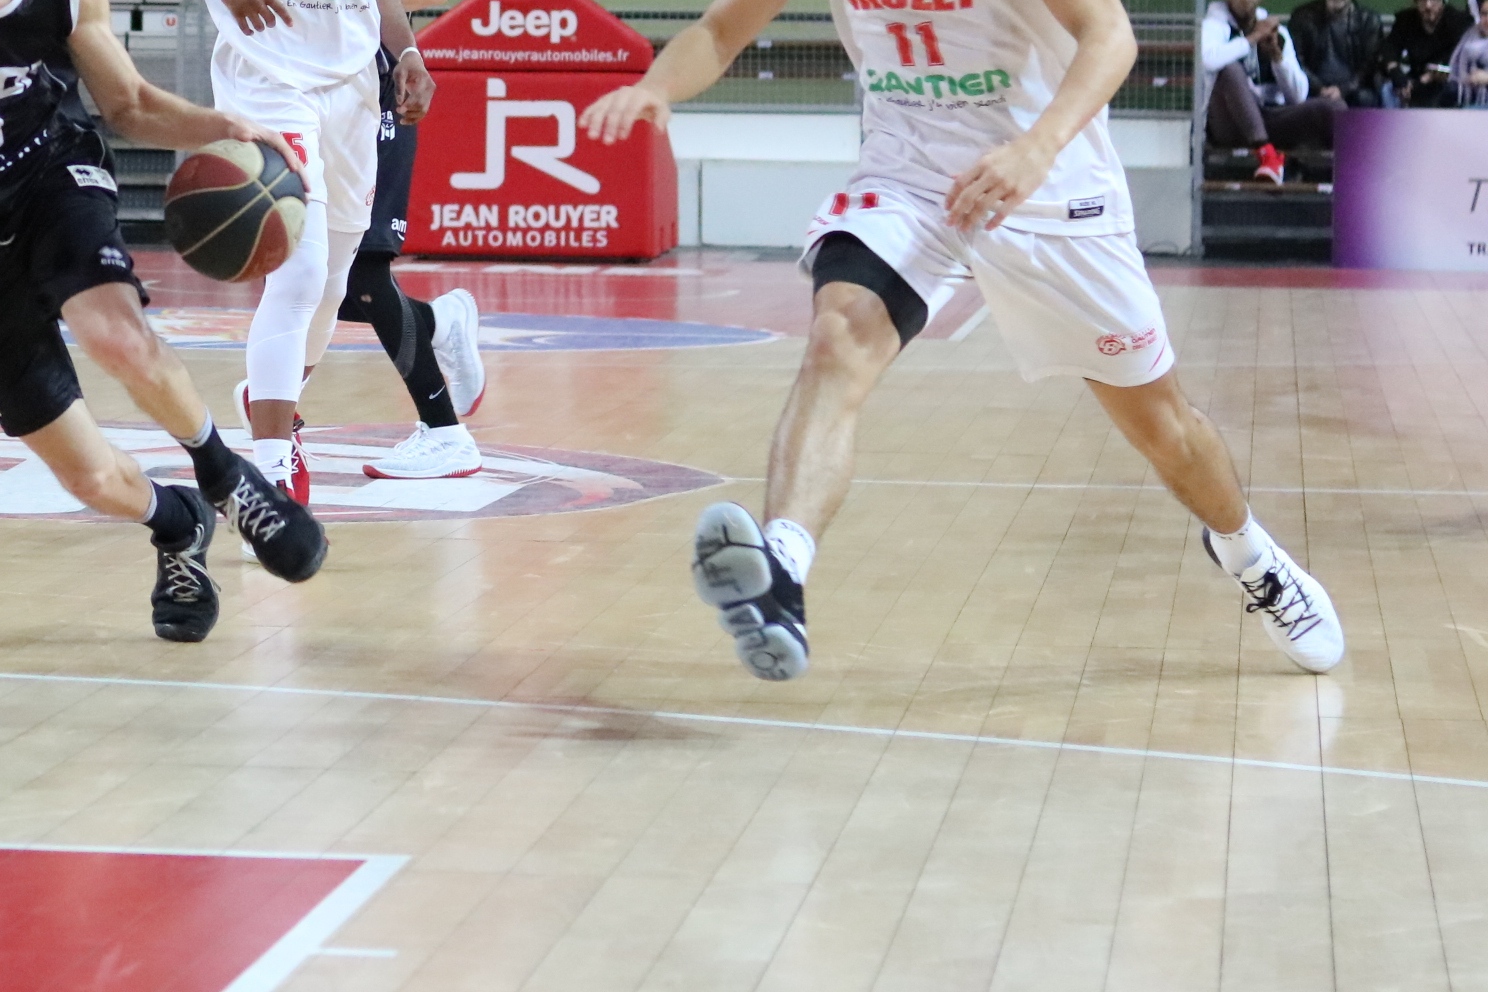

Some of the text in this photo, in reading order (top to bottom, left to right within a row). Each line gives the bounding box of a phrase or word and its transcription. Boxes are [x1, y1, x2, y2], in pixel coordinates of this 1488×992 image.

[471, 0, 578, 44] Jeep
[423, 47, 630, 64] www.jeanrouyerautomobiles.fr
[885, 21, 945, 67] 11
[280, 131, 308, 168] 5
[430, 203, 619, 230] JEAN ROUYER
[442, 231, 608, 247] AUTOMOBILES
